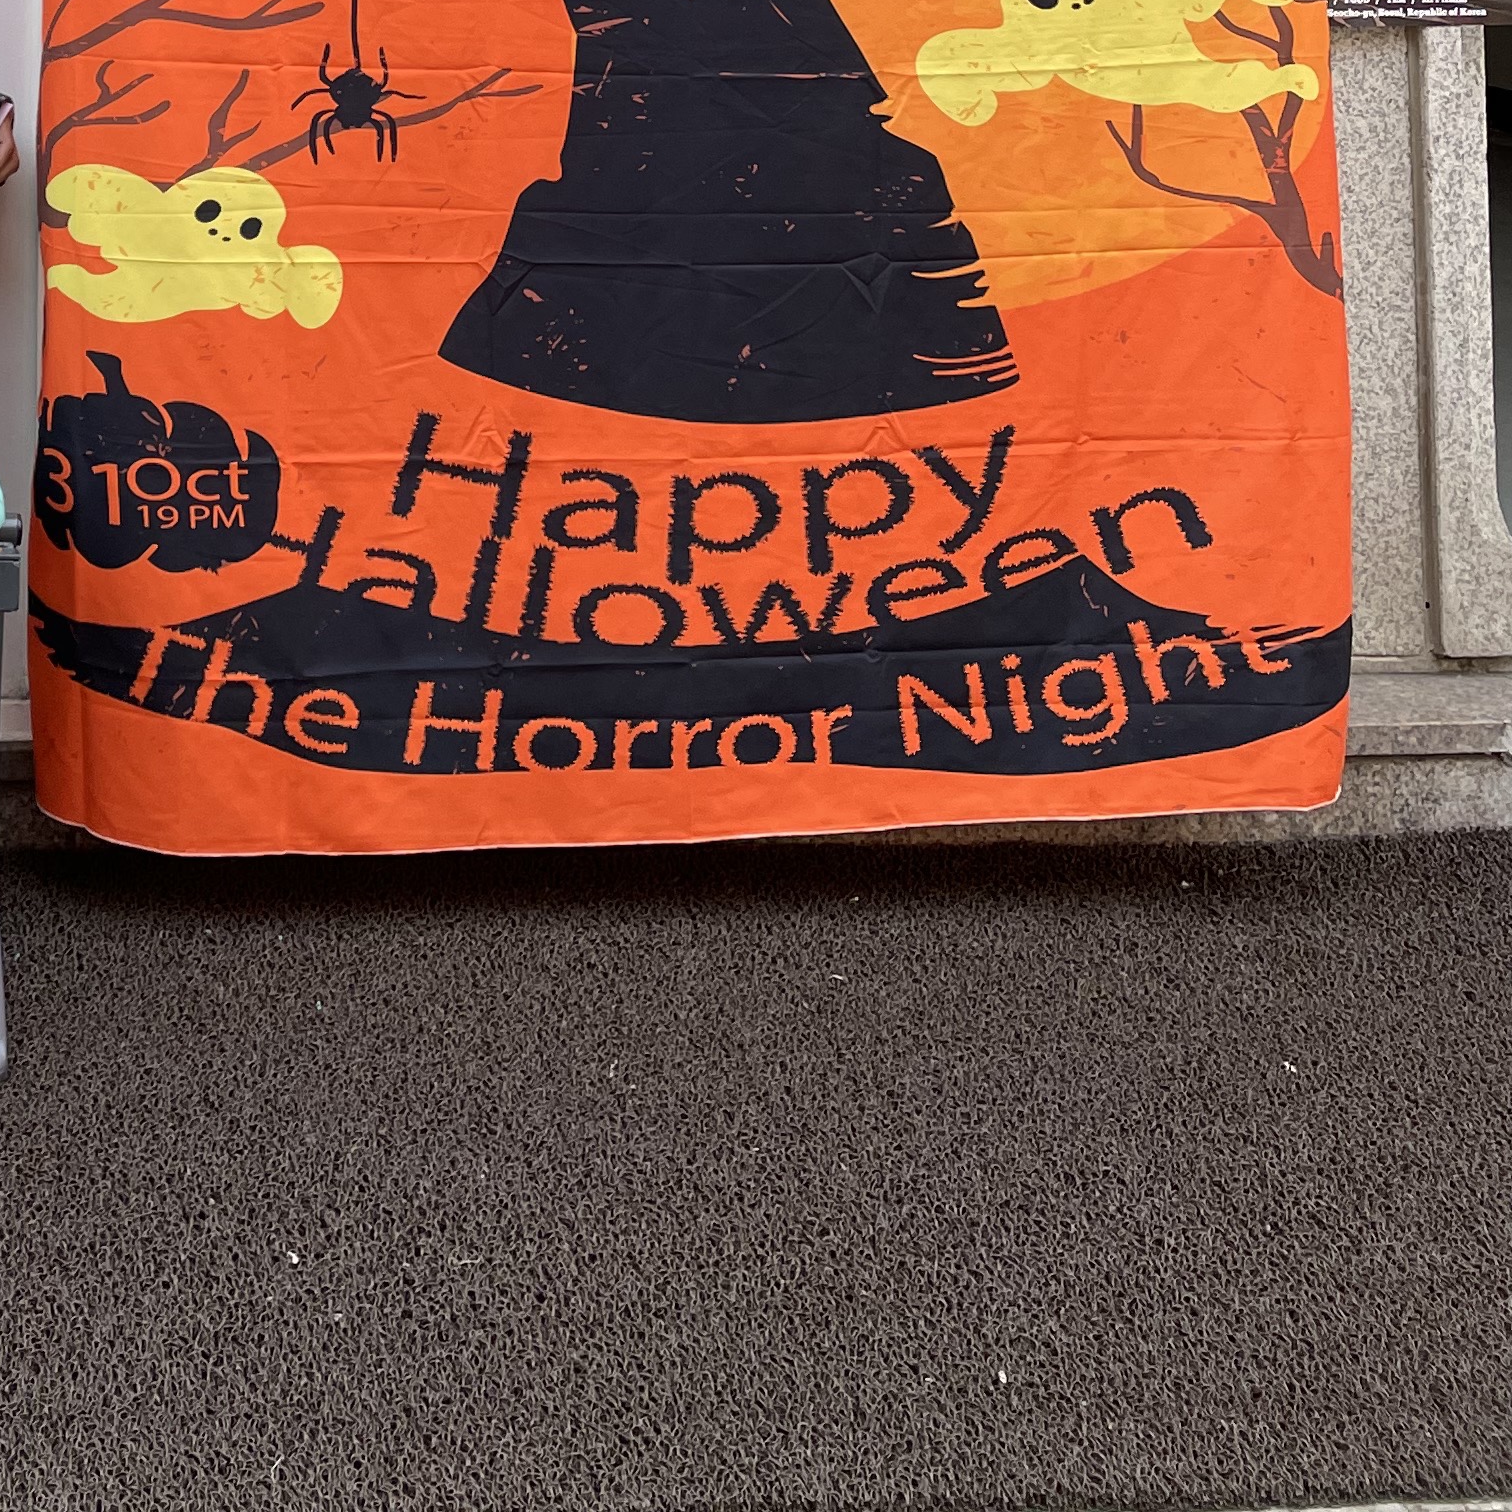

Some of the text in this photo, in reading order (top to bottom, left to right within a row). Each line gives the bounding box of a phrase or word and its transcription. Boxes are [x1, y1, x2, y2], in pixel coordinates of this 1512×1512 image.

[126, 457, 251, 502] Oct
[137, 503, 245, 530] 19 PM
[391, 408, 1016, 585] Happy
[270, 486, 1214, 646] Halloween
[129, 619, 1292, 772] The Horror Night
